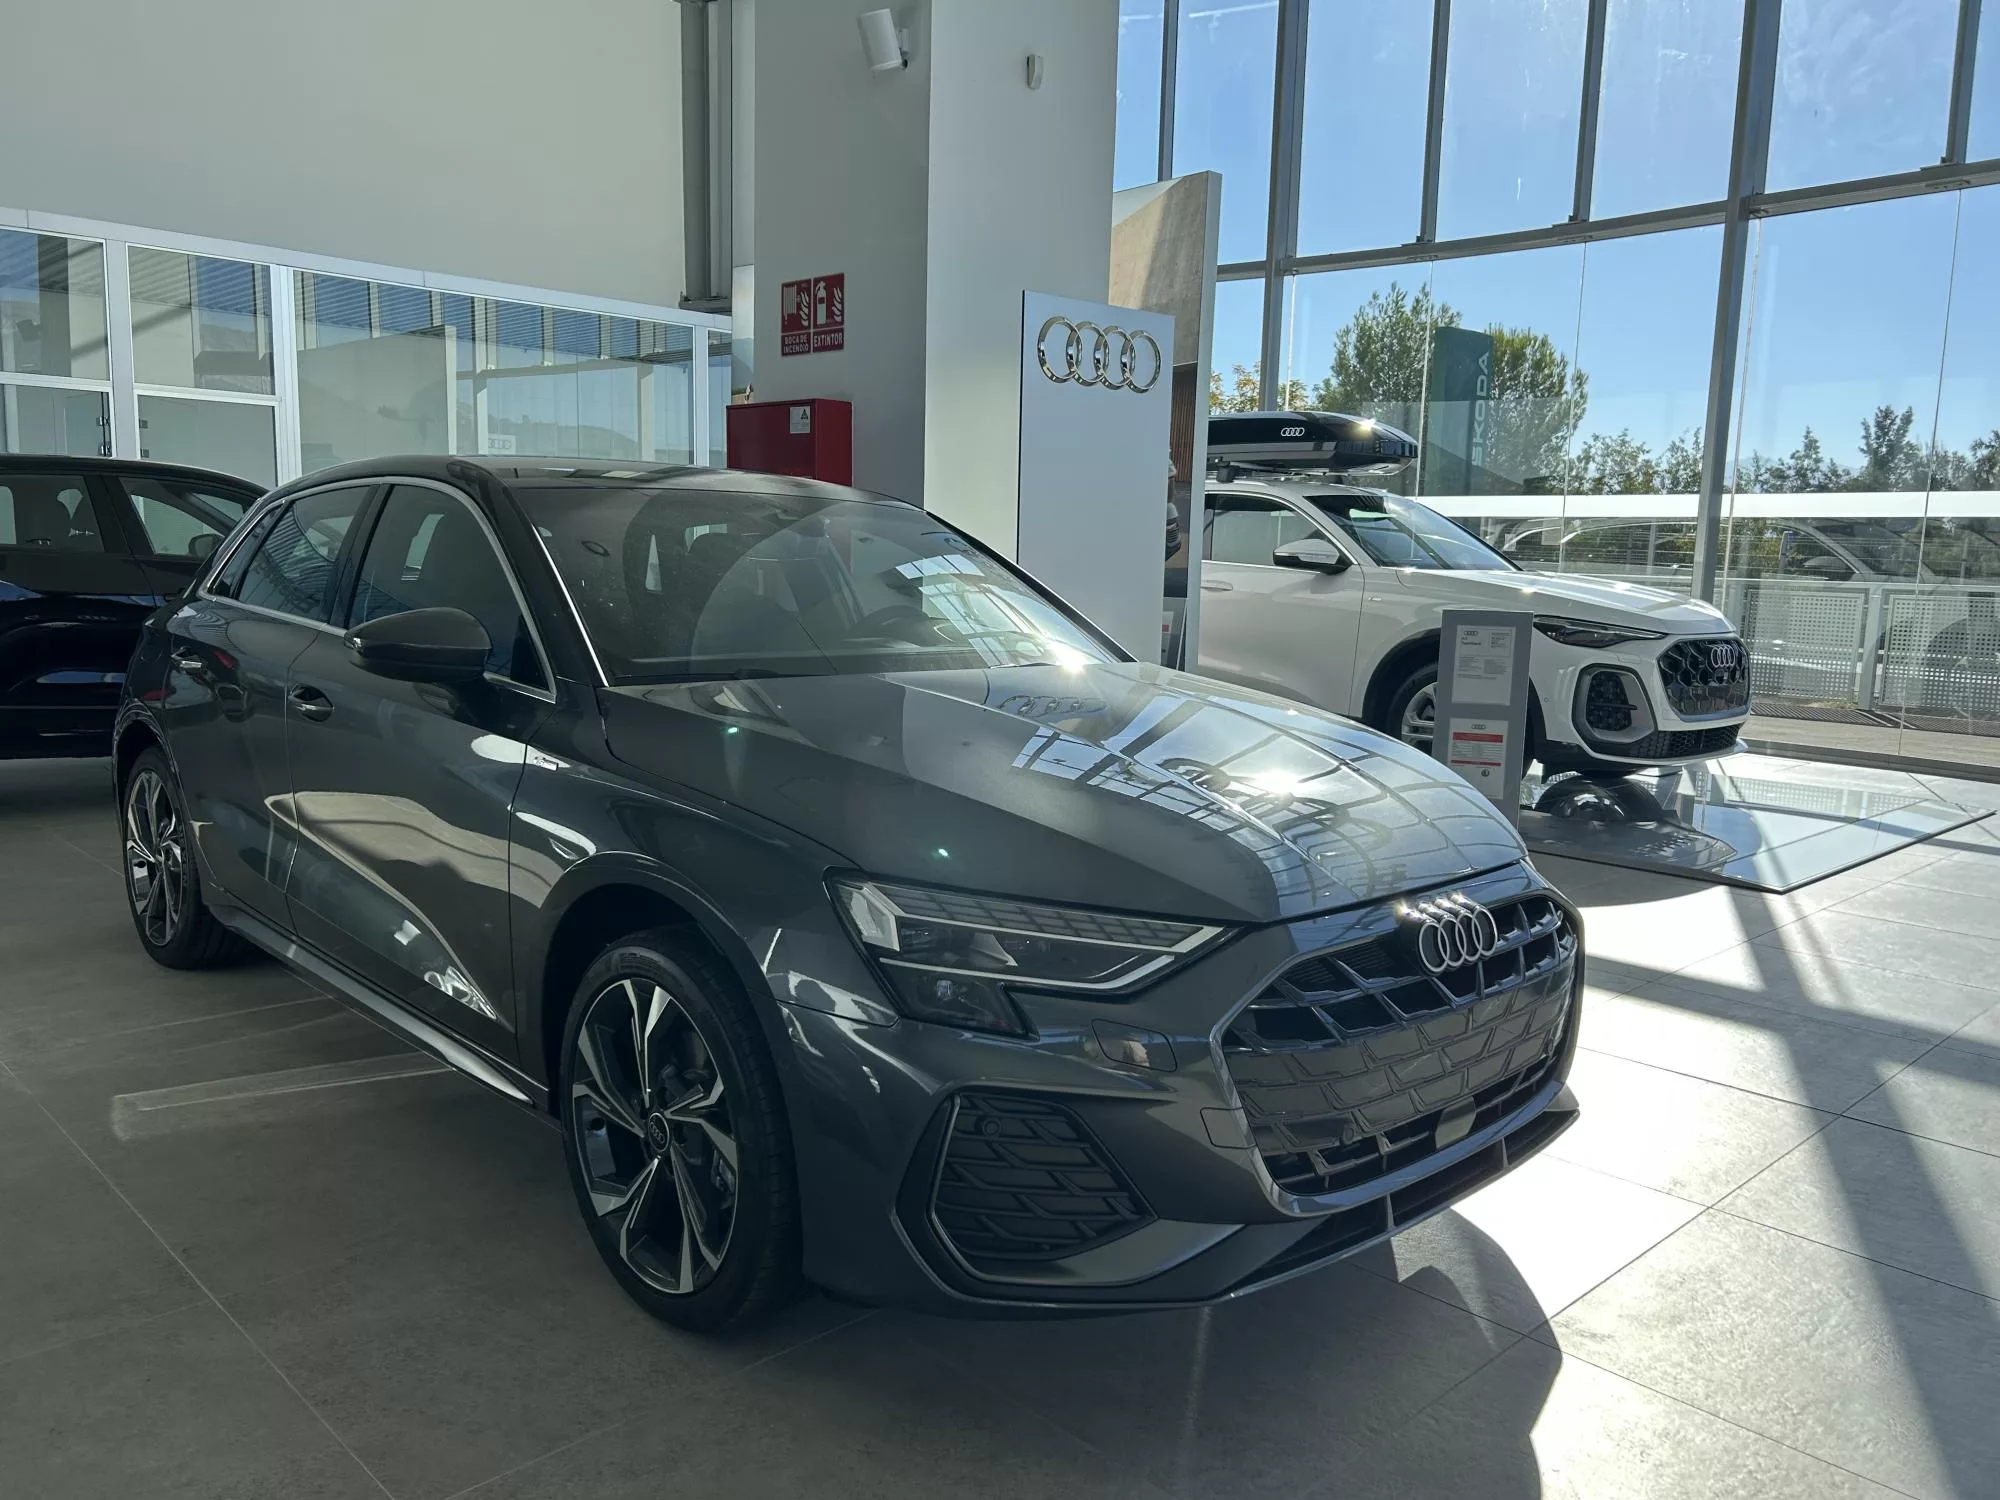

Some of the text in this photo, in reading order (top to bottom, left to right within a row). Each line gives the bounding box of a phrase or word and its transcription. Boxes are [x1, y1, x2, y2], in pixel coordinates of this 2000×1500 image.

[784, 334, 808, 344] BOCA DE
[814, 333, 842, 347] EXTINTOR
[783, 343, 808, 353] INCENDIO
